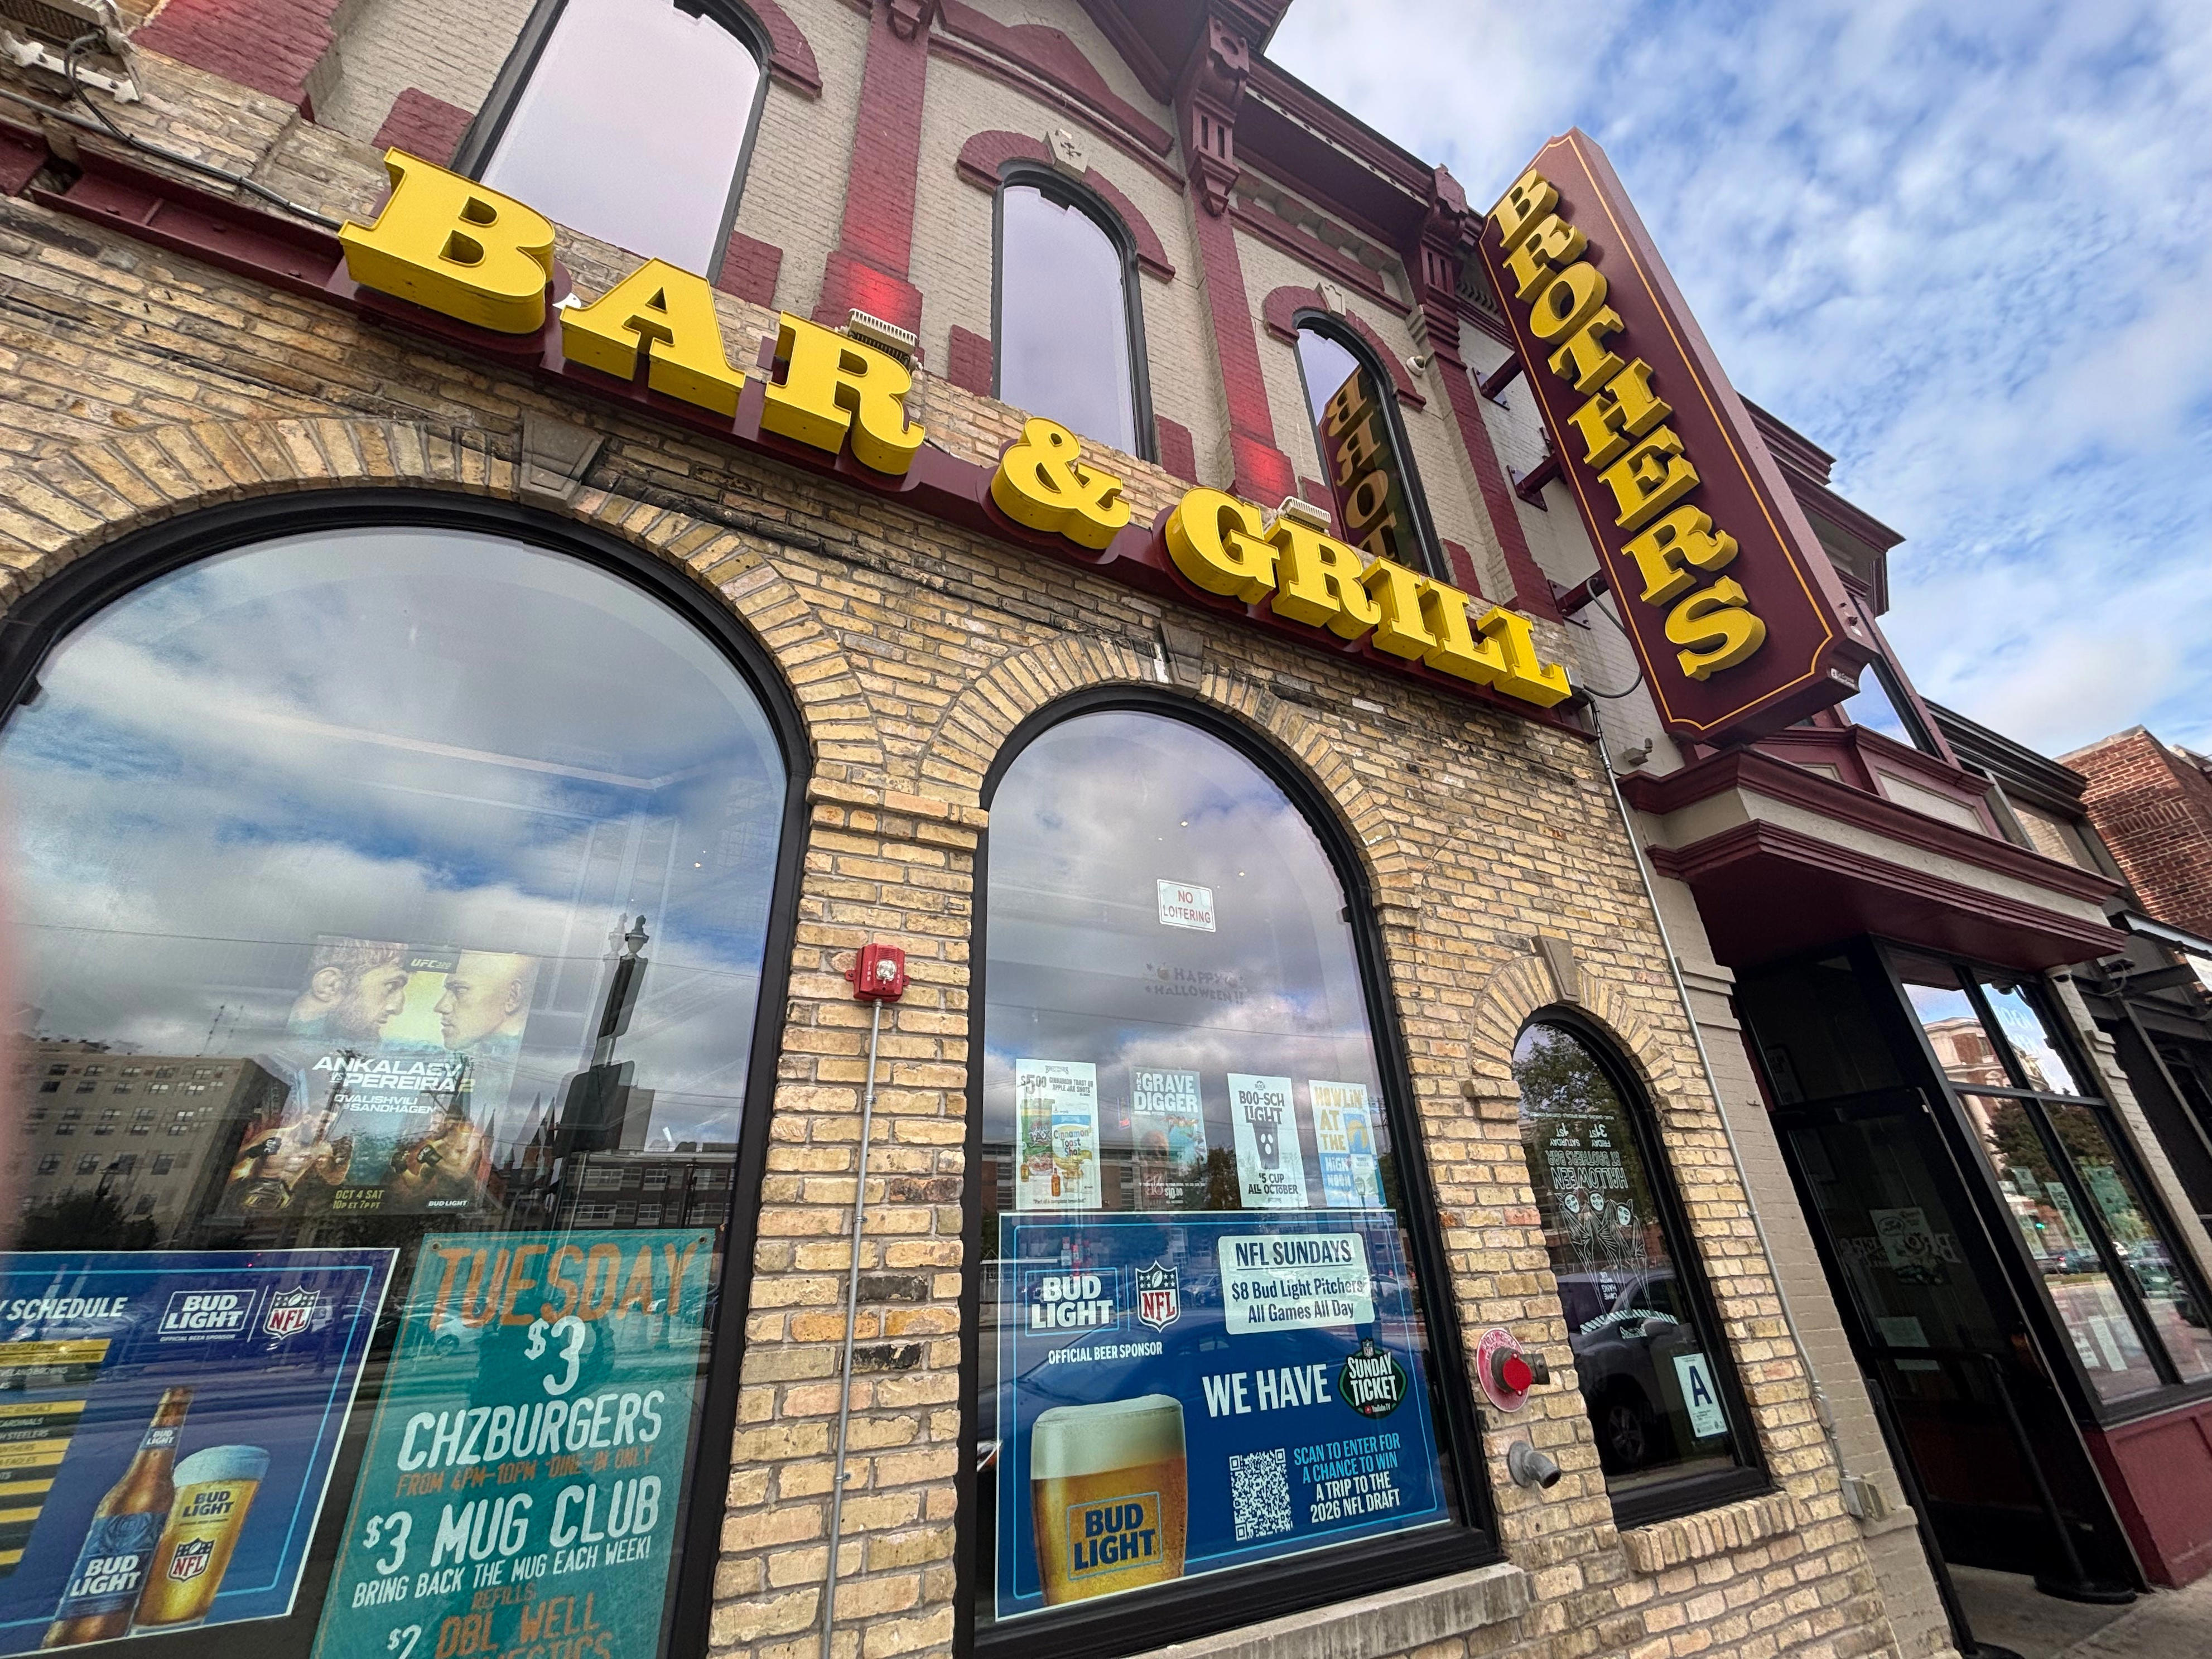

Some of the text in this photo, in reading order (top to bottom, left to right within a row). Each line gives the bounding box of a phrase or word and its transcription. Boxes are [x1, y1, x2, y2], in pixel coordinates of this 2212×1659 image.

[339, 147, 1572, 707] BAR & GRILL
[1488, 167, 1766, 681] BROTHERS
[1178, 890, 1193, 904] NO
[1163, 905, 1211, 924] LOITERING
[411, 958, 438, 968] UFC
[1174, 968, 1222, 984] HAPPY
[312, 1056, 462, 1077] ANKALAEV
[343, 1073, 456, 1092] PEREIRA
[459, 1078, 475, 1092] 2
[1143, 1073, 1195, 1094] GRAVE
[350, 1103, 437, 1114] SANDHAGEN
[1134, 1091, 1199, 1113] DIGGER
[1238, 1091, 1285, 1106] BOO-SCH
[1244, 1106, 1283, 1125] LIGHT
[1320, 1109, 1339, 1131] AT
[1053, 1130, 1090, 1139] Cinnamon
[1589, 1123, 1607, 1138] 31ST
[1061, 1138, 1081, 1148] Toast
[1064, 1147, 1081, 1156] Shot
[1320, 1134, 1346, 1151] THE
[1550, 1137, 1611, 1147] FRIDAY SATURDAY
[1545, 1150, 1565, 1166] BAR
[1565, 1150, 1611, 1166] BROTHERS
[1259, 1173, 1284, 1184] $5 CUP
[1550, 1167, 1628, 1189] HALLOWEEN
[336, 1189, 385, 1199] OCT 4 SAT
[1249, 1184, 1262, 1195] ALL
[1235, 1240, 1352, 1266] NFL SUNDAYS
[428, 1242, 697, 1331] TUESDAY
[1043, 1275, 1102, 1301] BUD
[1232, 1277, 1363, 1302] $8 Bud Light Pitchers
[1601, 1284, 1617, 1293] HANG
[1603, 1292, 1617, 1300] COME
[6, 1296, 129, 1321] SCHEDULE
[182, 1294, 239, 1311] BUD
[1143, 1291, 1175, 1322] NFL
[1249, 1299, 1354, 1323] All Games All Day
[165, 1311, 244, 1329] LIGHT
[269, 1309, 305, 1332] NFL
[1032, 1300, 1113, 1329] LIGHT
[524, 1315, 586, 1395] $3
[1048, 1341, 1163, 1364] OFFICIAL BEER SPONSOR
[1347, 1352, 1393, 1380] SUNDAY
[1202, 1363, 1332, 1417] WE HAVE
[1350, 1375, 1397, 1407] TICKET
[1689, 1366, 1713, 1407] A
[1385, 1402, 1391, 1411] TV
[7, 1429, 50, 1440] STEELERS
[146, 1436, 175, 1445] LIGHT
[397, 1391, 665, 1471] CHZBURGERS
[1294, 1432, 1401, 1466] SCAN TO ENTER FOR
[396, 1472, 445, 1498] FROM
[451, 1459, 537, 1491] 4PM-10PM
[615, 1445, 653, 1469] ONLY
[1303, 1451, 1398, 1484] A CHANCE TO WIN
[194, 1491, 231, 1504] BUD
[1316, 1471, 1392, 1502] A TRIP TO THE
[182, 1502, 234, 1518] LIGHT
[1310, 1488, 1400, 1523] 2026 NFL DRAFT
[363, 1475, 661, 1575] $3 MUG CLUB
[1085, 1503, 1144, 1538] BUD
[1074, 1528, 1155, 1571] LIGHT
[85, 1555, 139, 1578] BUD
[172, 1555, 204, 1577] NFL
[352, 1536, 651, 1608] BRING BACK THE MUG EACH WEEK!
[69, 1571, 141, 1597] LIGHT
[434, 1610, 498, 1659] DBL
[519, 1591, 600, 1644] WELL
